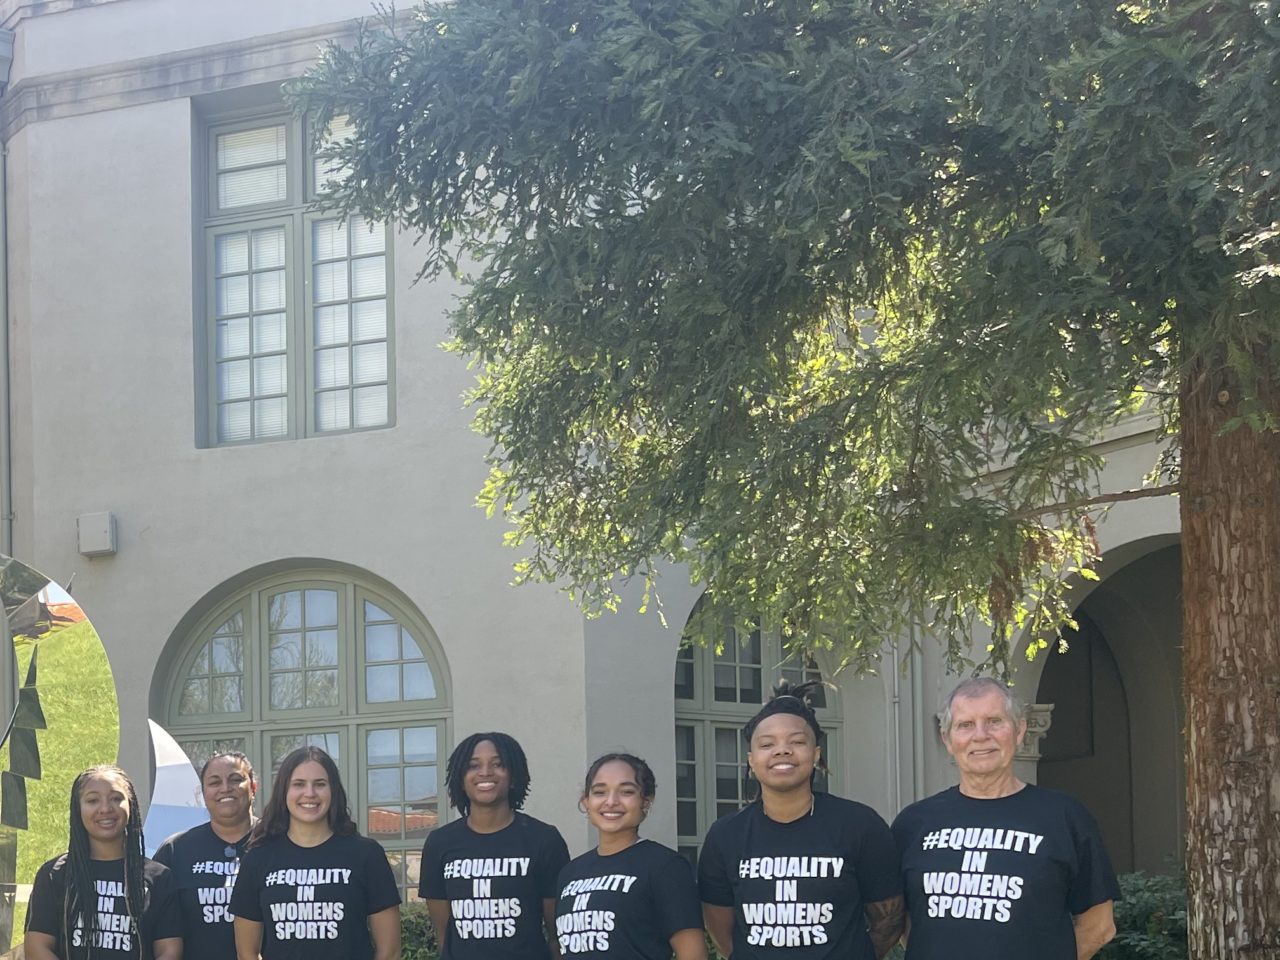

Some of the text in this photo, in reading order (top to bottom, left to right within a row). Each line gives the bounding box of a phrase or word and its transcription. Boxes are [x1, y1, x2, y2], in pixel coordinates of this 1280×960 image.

[922, 827, 1044, 855] #EQUALITY
[444, 857, 530, 879] #EQUALITY
[739, 857, 844, 879] #EQUALITY
[961, 851, 987, 873] IN
[265, 868, 352, 887] #EQUALITY
[473, 879, 491, 898] IN
[923, 872, 1024, 900] WOMENS
[297, 886, 314, 902] IN
[572, 892, 592, 912] IN
[775, 880, 798, 902] IN
[97, 896, 115, 913] IN
[270, 902, 344, 923] WOMENS
[451, 897, 522, 919] WOMENS
[742, 903, 834, 926] WOMENS
[927, 896, 1012, 923] SPORTS
[275, 921, 338, 940] SPORTS
[455, 918, 516, 940] SPORTS
[555, 910, 616, 937] WOMENS
[558, 931, 610, 956] SPORTS
[747, 925, 828, 948] SPORTS
